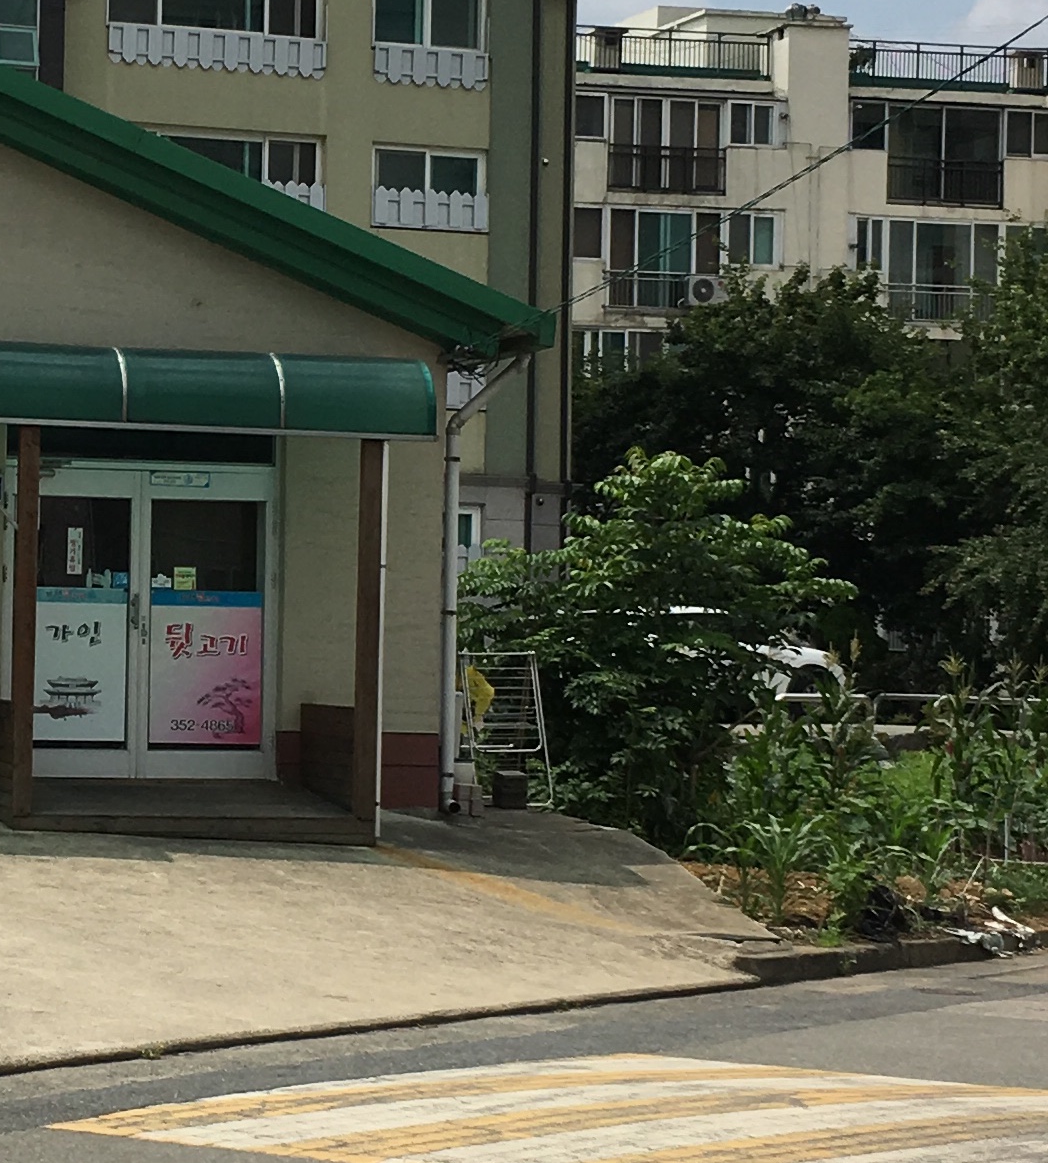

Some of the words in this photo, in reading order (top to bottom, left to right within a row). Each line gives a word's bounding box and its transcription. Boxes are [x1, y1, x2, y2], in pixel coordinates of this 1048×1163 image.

[46, 621, 102, 647] 가인
[165, 622, 249, 660] 뒷고기
[170, 719, 234, 732] 352-4865
